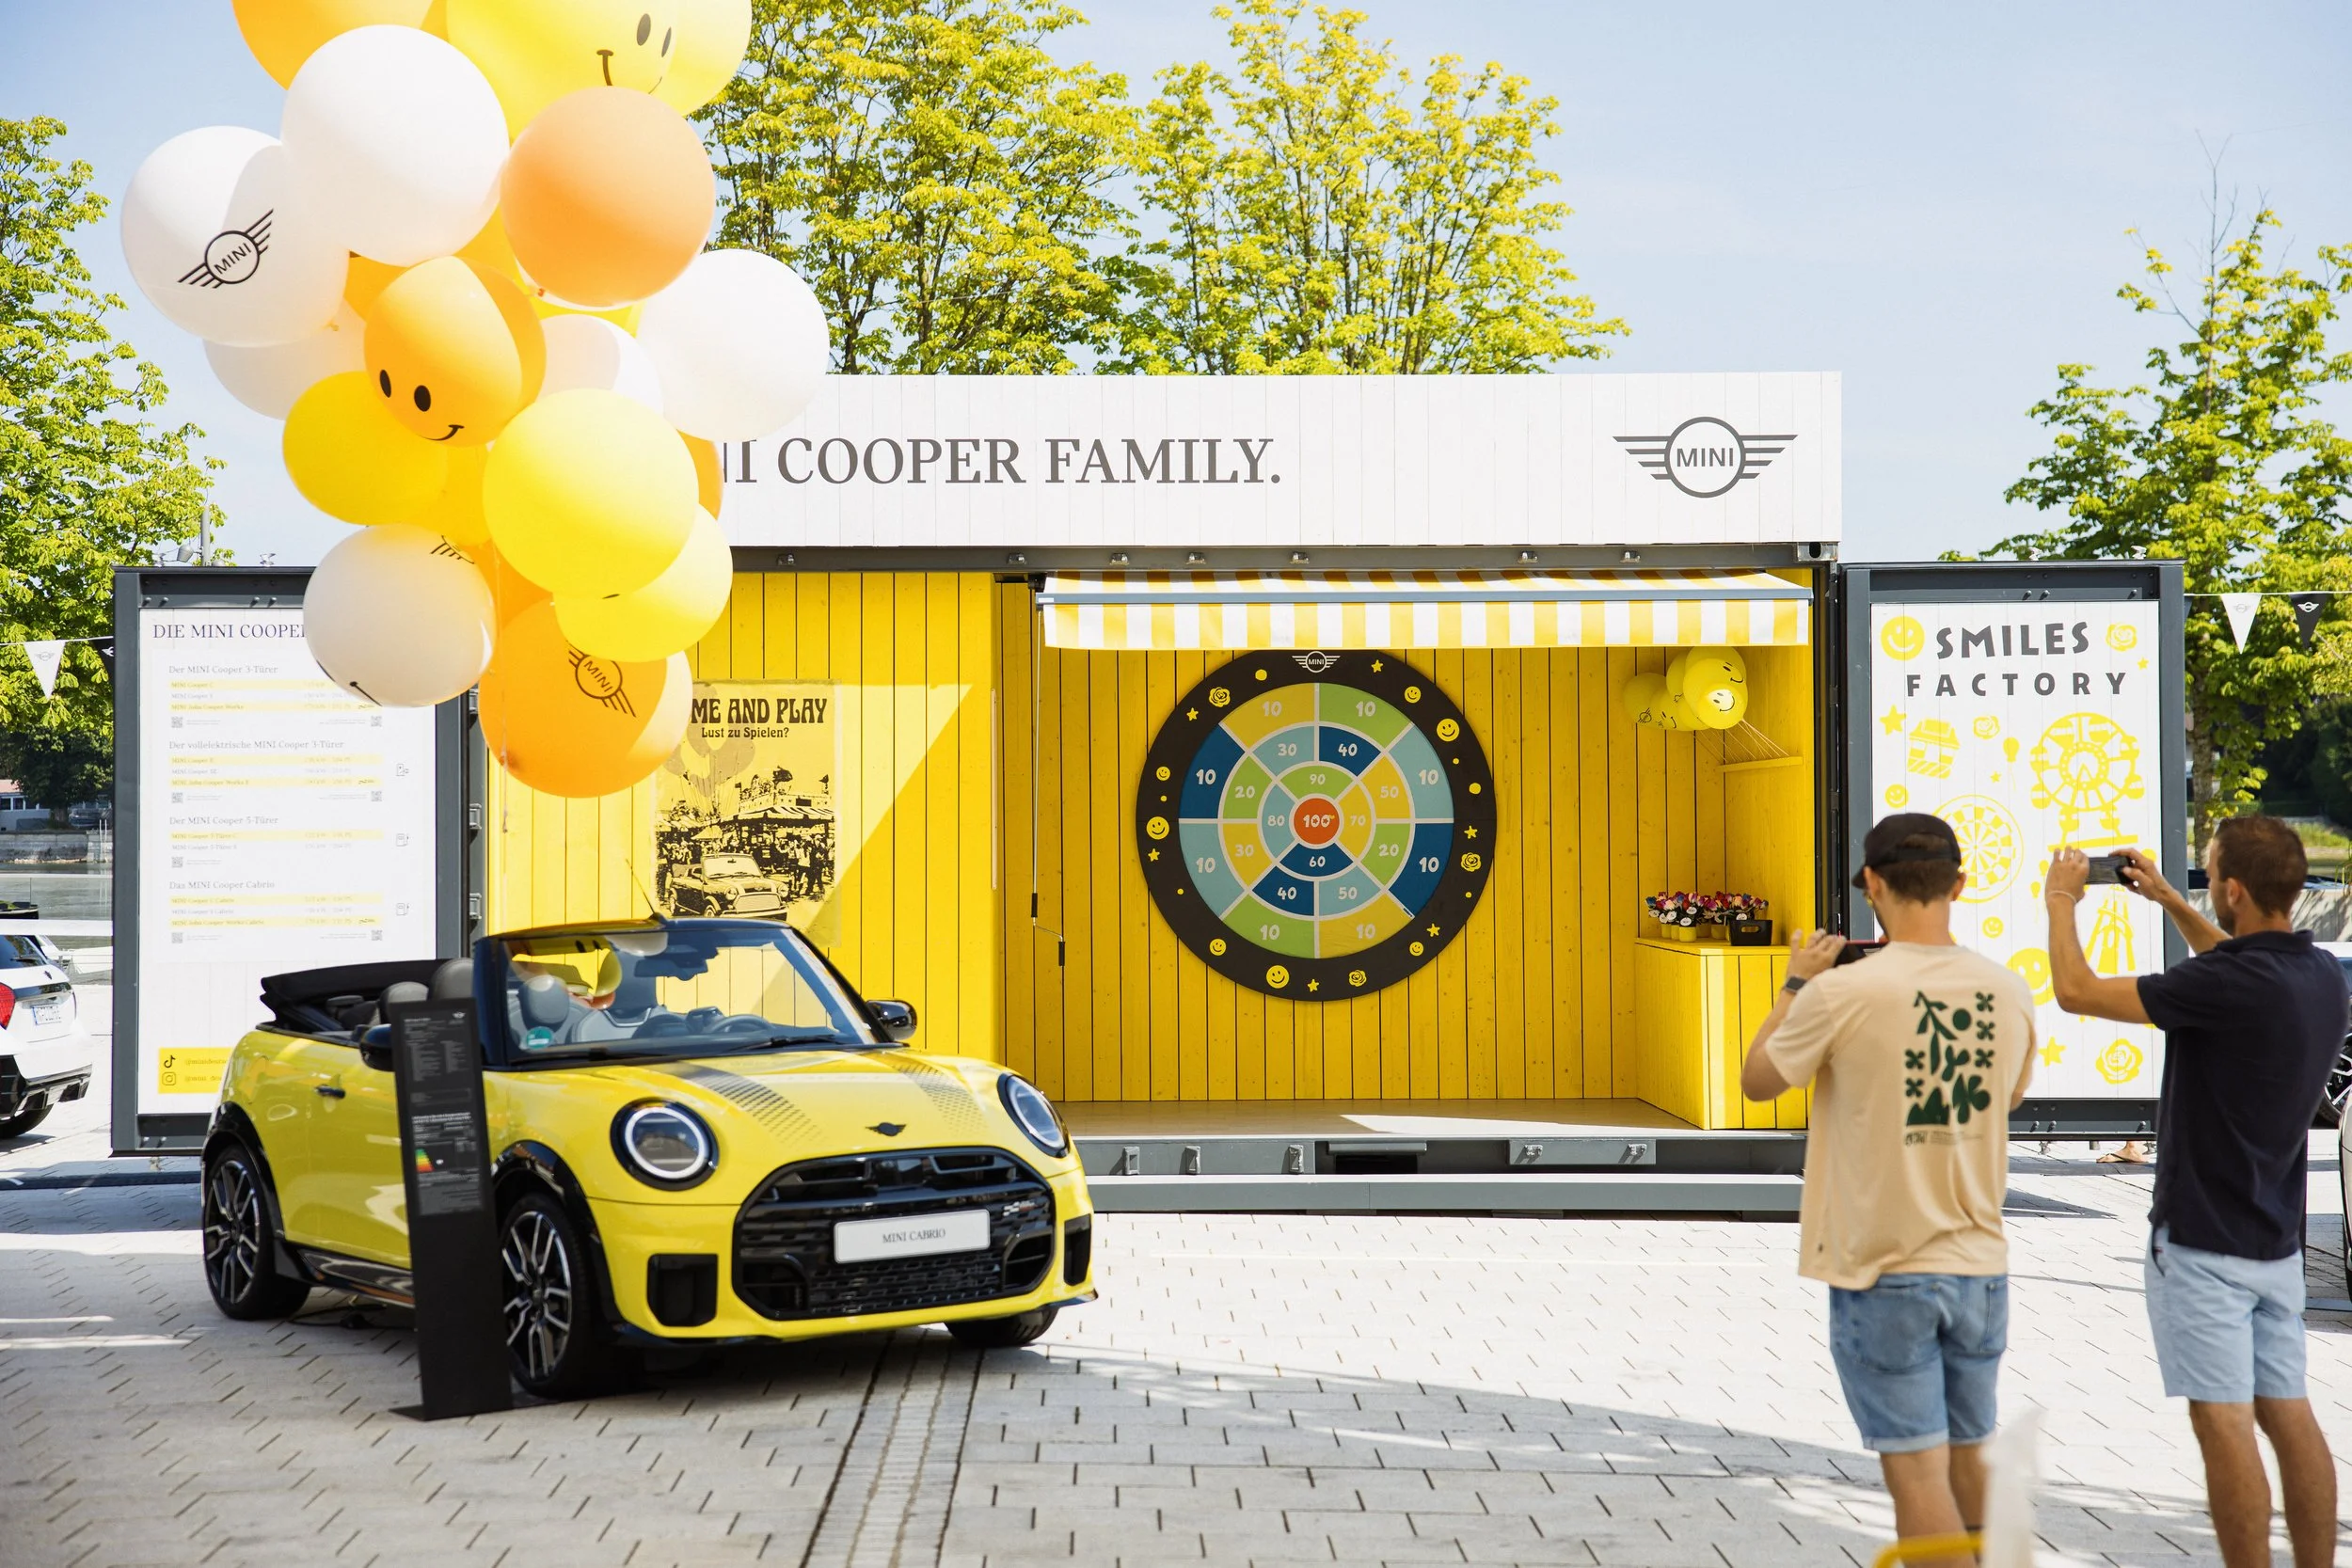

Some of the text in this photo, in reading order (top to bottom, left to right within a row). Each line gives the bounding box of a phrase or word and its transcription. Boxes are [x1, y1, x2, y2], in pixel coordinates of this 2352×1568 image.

[214, 243, 252, 275] MINI
[777, 437, 1027, 484] COOPER
[1044, 438, 1280, 483] FAMILY.
[1676, 447, 1734, 467] MINI
[153, 624, 185, 639] DIE
[190, 624, 234, 639] MINI
[1936, 621, 2090, 659] SMILES
[168, 664, 279, 675] Der MINI Cooper 3-Türer
[583, 660, 613, 692] MINI
[1906, 673, 2126, 697] FACTORY
[691, 698, 827, 724] ME AND PLAY
[1262, 701, 1282, 717] 10
[1355, 701, 1376, 717] 10
[701, 727, 789, 740] Lust zu Spielen?
[168, 740, 185, 749] Der
[187, 740, 252, 750] vollelektrische
[254, 740, 277, 749] MINI
[278, 740, 310, 751] Cooper
[1278, 743, 1297, 757] 30
[1338, 743, 1358, 757] 40
[1196, 768, 1216, 784] 10
[1309, 774, 1326, 785] 90
[1419, 768, 1439, 784] 10
[1234, 785, 1255, 799] 20
[1379, 785, 1399, 799] 50
[168, 816, 185, 824] Der
[187, 816, 211, 824] MINI
[212, 816, 244, 827] Cooper
[1267, 815, 1285, 827] 80
[1302, 814, 1331, 829] 100
[1349, 815, 1366, 827] 70
[1234, 844, 1254, 857] 30
[1378, 844, 1399, 857] 20
[1196, 857, 1216, 873] 10
[1309, 856, 1326, 868] 60
[1419, 857, 1439, 873] 10
[187, 880, 211, 889] MINI
[212, 880, 244, 893] Cooper
[246, 880, 276, 889] Cabrio
[1277, 886, 1297, 900] 40
[1338, 886, 1358, 900] 50
[1260, 925, 1280, 941] 10
[1356, 924, 1376, 940] 10
[882, 1227, 946, 1243] MINI CABRIO
